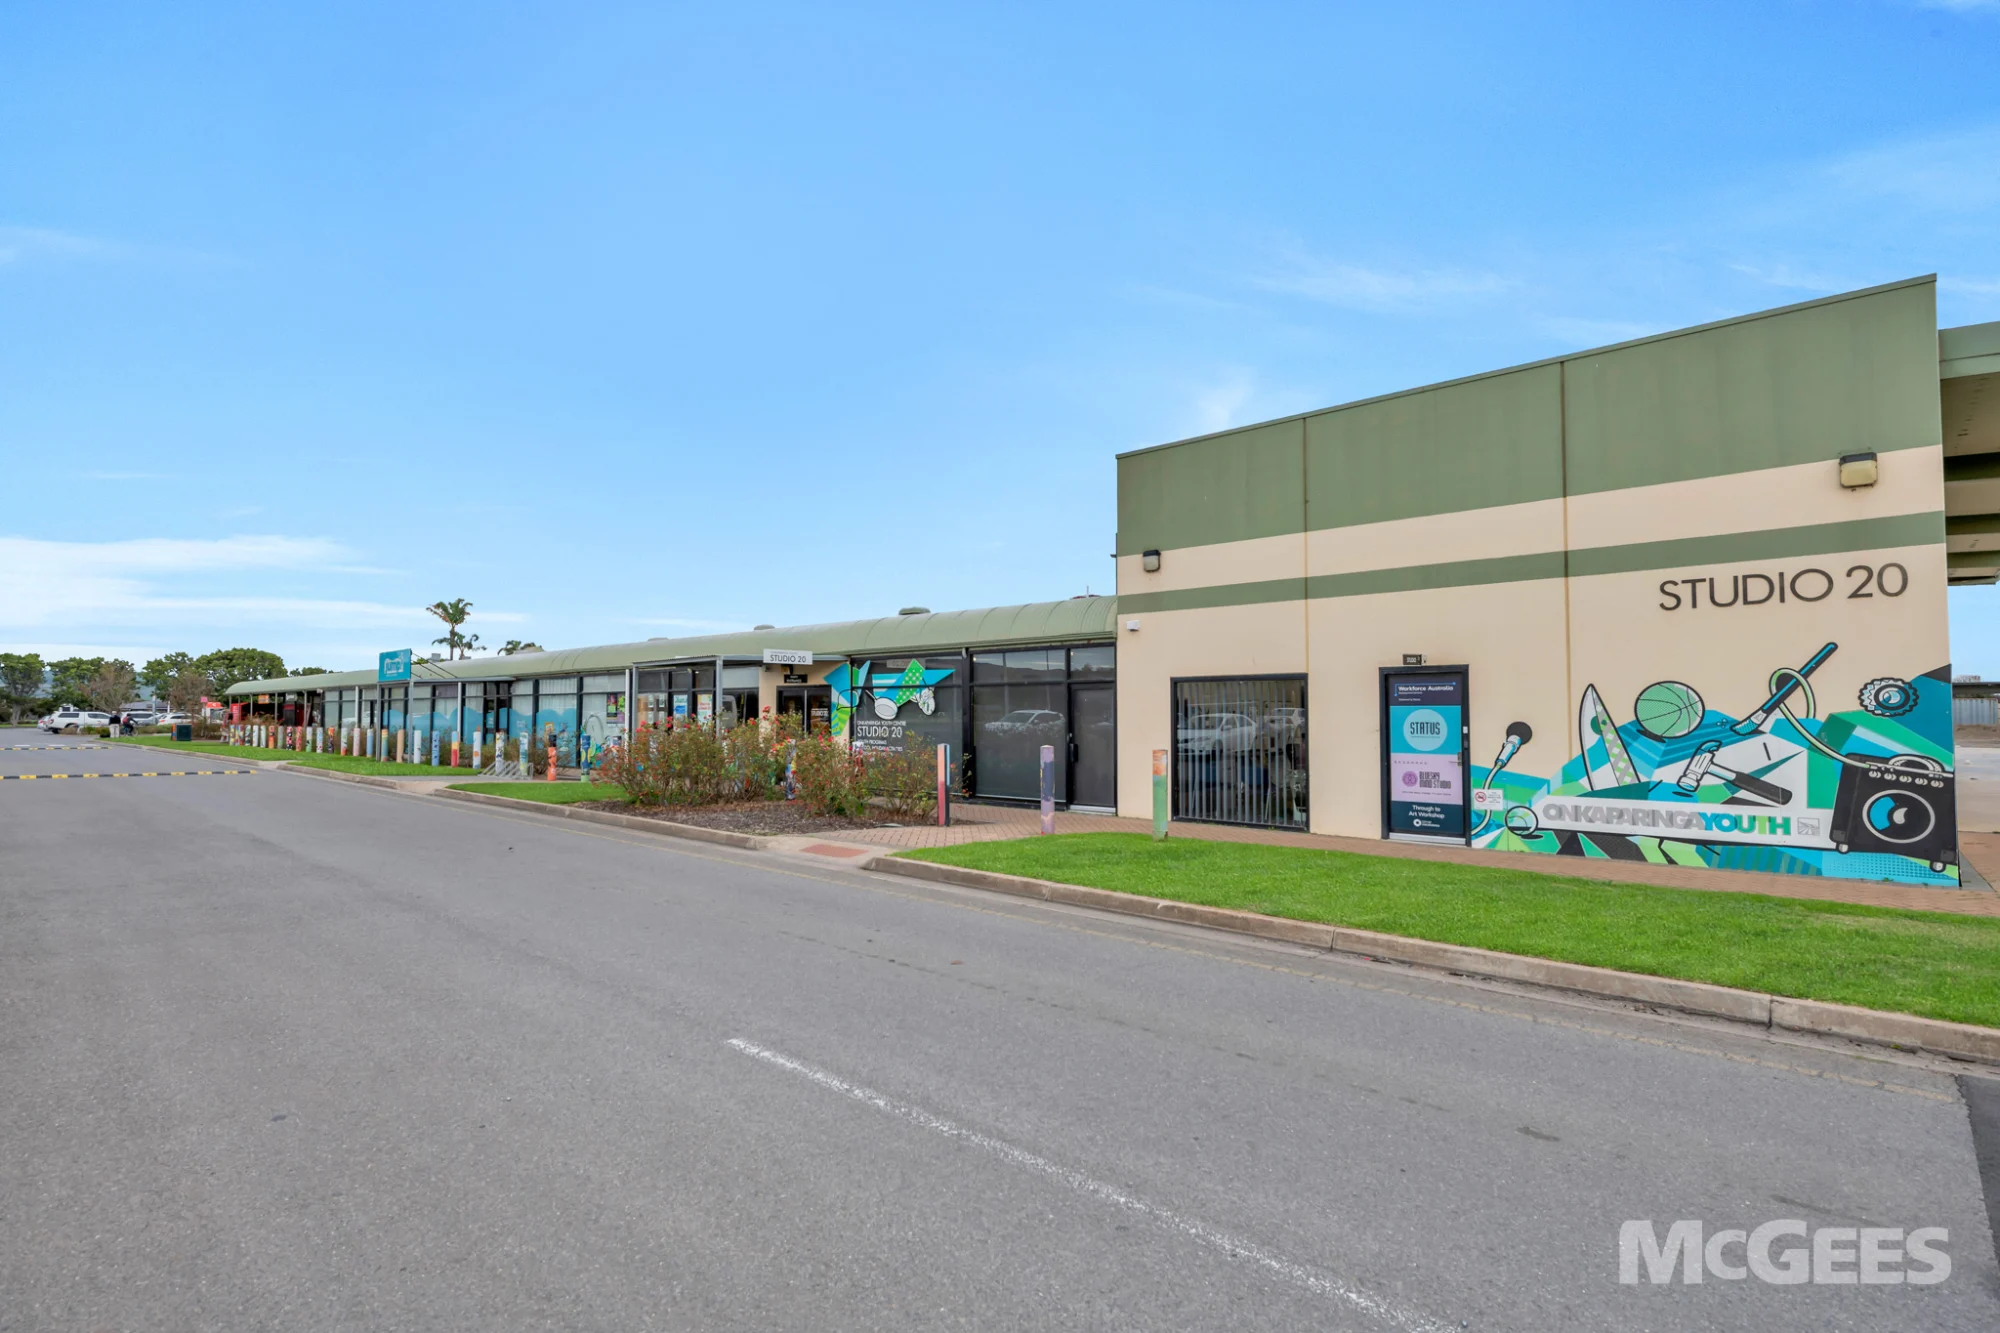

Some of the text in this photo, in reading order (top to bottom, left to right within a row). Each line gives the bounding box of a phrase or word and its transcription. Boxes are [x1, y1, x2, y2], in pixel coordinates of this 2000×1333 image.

[1659, 562, 1909, 611] STUDIO 20
[769, 654, 807, 663] STUDIO 20
[857, 726, 903, 738] STUDIO 20
[1409, 721, 1441, 735] STATUS
[1412, 804, 1434, 812] Through
[1418, 811, 1445, 819] Workshop
